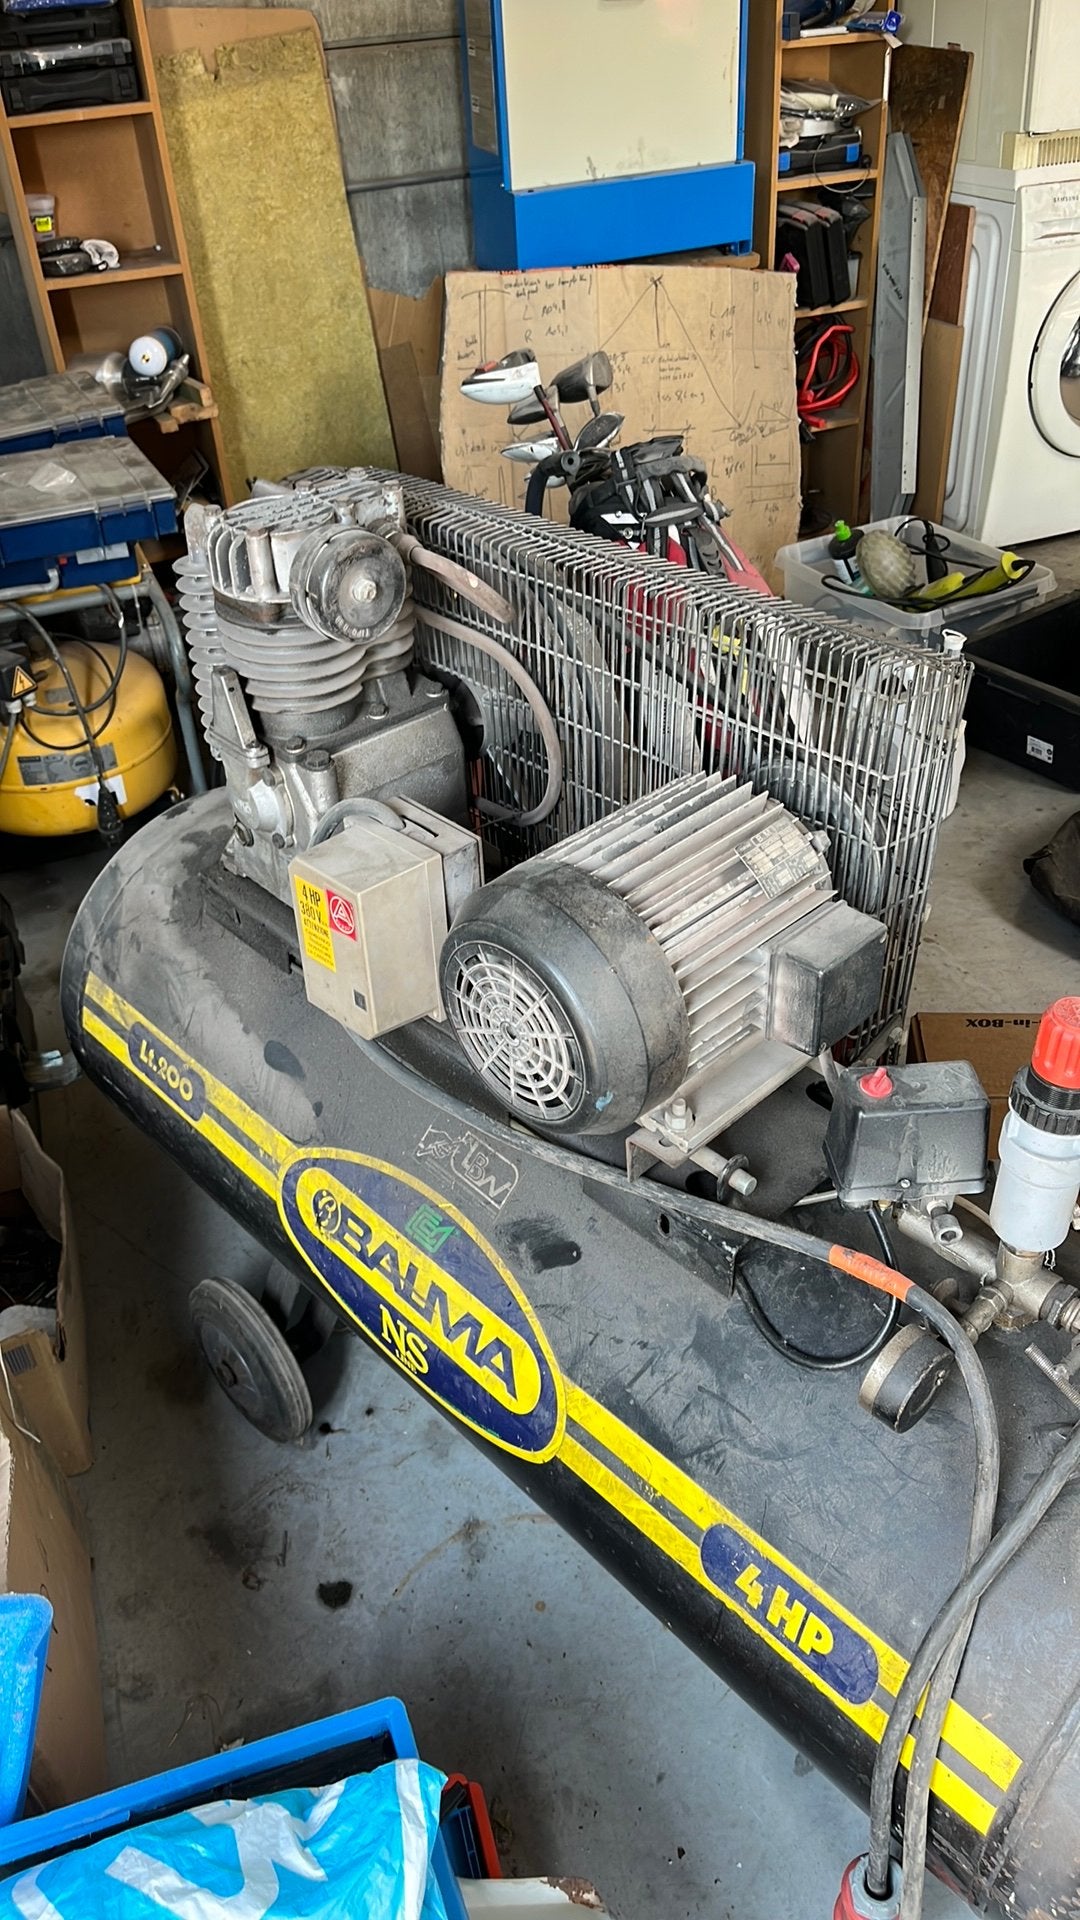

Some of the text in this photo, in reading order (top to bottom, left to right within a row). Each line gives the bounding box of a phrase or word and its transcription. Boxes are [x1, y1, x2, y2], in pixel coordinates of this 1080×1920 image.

[302, 884, 321, 907] 4 HP
[336, 1205, 518, 1402] BALMA
[379, 1303, 429, 1375] NS
[734, 1562, 834, 1656] 4 HP
